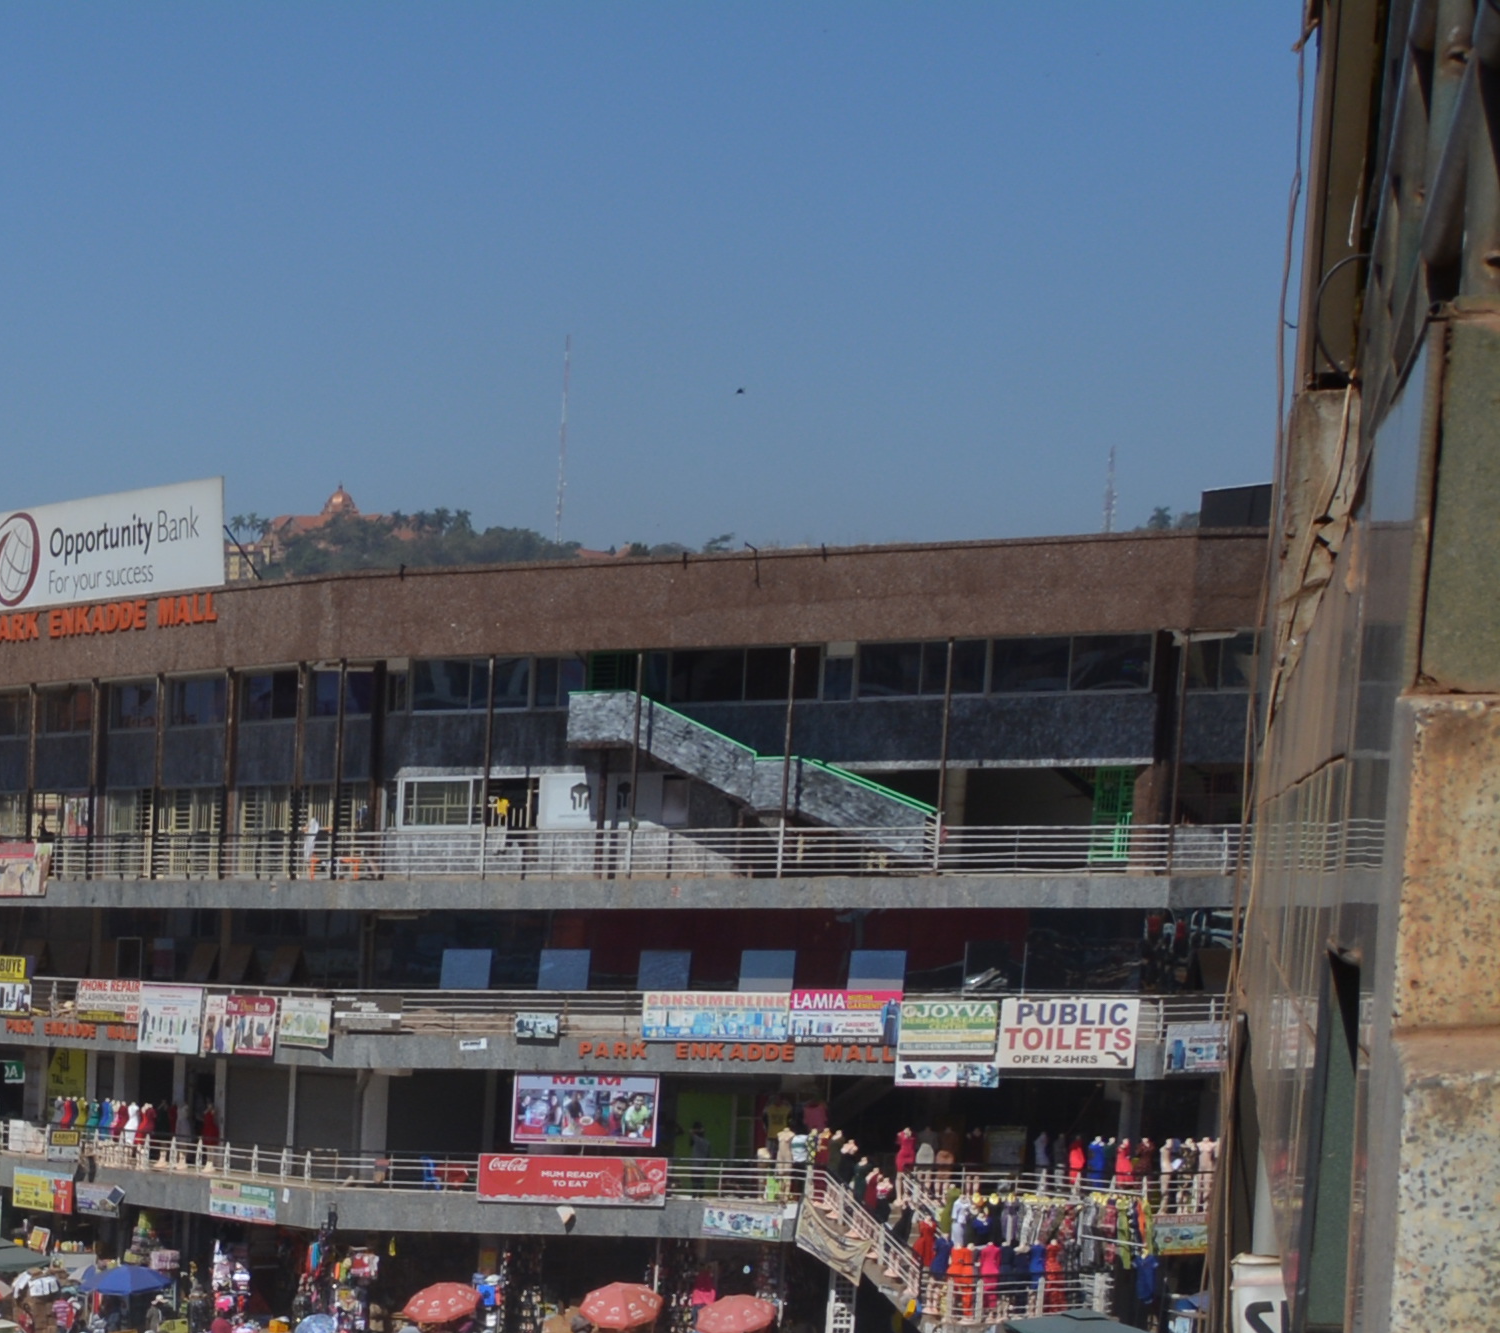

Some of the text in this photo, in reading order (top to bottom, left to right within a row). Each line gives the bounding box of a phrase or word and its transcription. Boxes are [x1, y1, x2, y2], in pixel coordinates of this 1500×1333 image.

[49, 505, 200, 566] Opportunity Bank
[49, 563, 154, 600] For your success
[49, 599, 148, 639] ENKADDE
[156, 592, 219, 628] MALL
[647, 993, 787, 1008] CONSUMERLINK
[793, 992, 846, 1010] LAMIA
[916, 1004, 996, 1019] JOYVA
[1016, 1002, 1129, 1026] PUBLIC
[1004, 1027, 1132, 1051] TOILETS
[578, 1041, 896, 1063] PARK ENKADDE MALL
[1012, 1054, 1099, 1065] OPEN 24HRS
